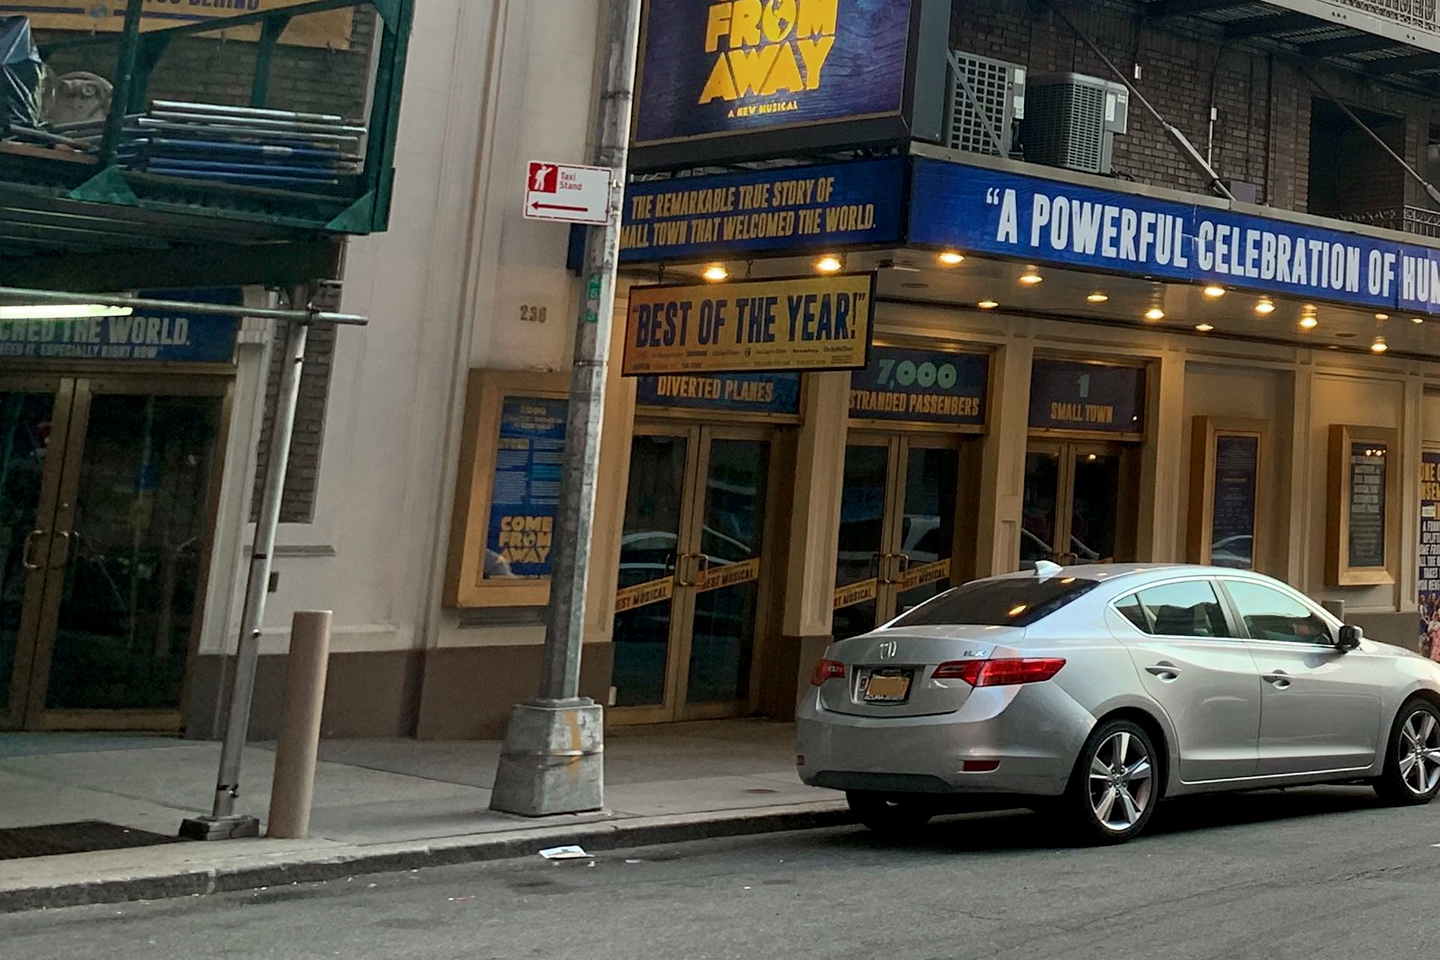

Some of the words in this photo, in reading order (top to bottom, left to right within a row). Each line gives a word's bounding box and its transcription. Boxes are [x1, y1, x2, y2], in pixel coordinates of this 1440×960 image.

[698, 36, 836, 104] AWAY
[727, 109, 736, 119] A
[736, 105, 757, 117] NEW
[758, 100, 798, 115] MUSICAL
[559, 180, 583, 191] Stand
[560, 171, 576, 181] Taxi
[632, 195, 653, 220] THE
[655, 186, 736, 218] REMARKABLE
[739, 184, 768, 210] TRUE
[772, 179, 814, 207] STORY
[817, 177, 835, 203] OF
[653, 220, 689, 246] TOWN
[691, 217, 721, 243] THAT
[723, 209, 796, 240] WELCOMED
[798, 208, 822, 235] THE
[825, 203, 877, 232] WORLD.
[1030, 193, 1189, 268] POWERFUL
[1199, 220, 1361, 294] CELEBRATION
[1368, 248, 1397, 297] OF
[109, 317, 191, 346] WORLD.
[700, 297, 728, 346] OF
[736, 296, 779, 345] THE
[877, 358, 957, 390] 7,000
[1077, 373, 1090, 398] 1
[657, 375, 721, 400] DIVERTED
[724, 379, 775, 403] PLANES
[850, 389, 907, 414] STRANDED
[909, 393, 980, 417] PASSENGERS
[1050, 402, 1083, 422] SMALL
[1085, 404, 1114, 422] TOWN
[501, 516, 553, 532] COME
[498, 546, 549, 564] AWAY
[633, 587, 667, 606] MUSICAL
